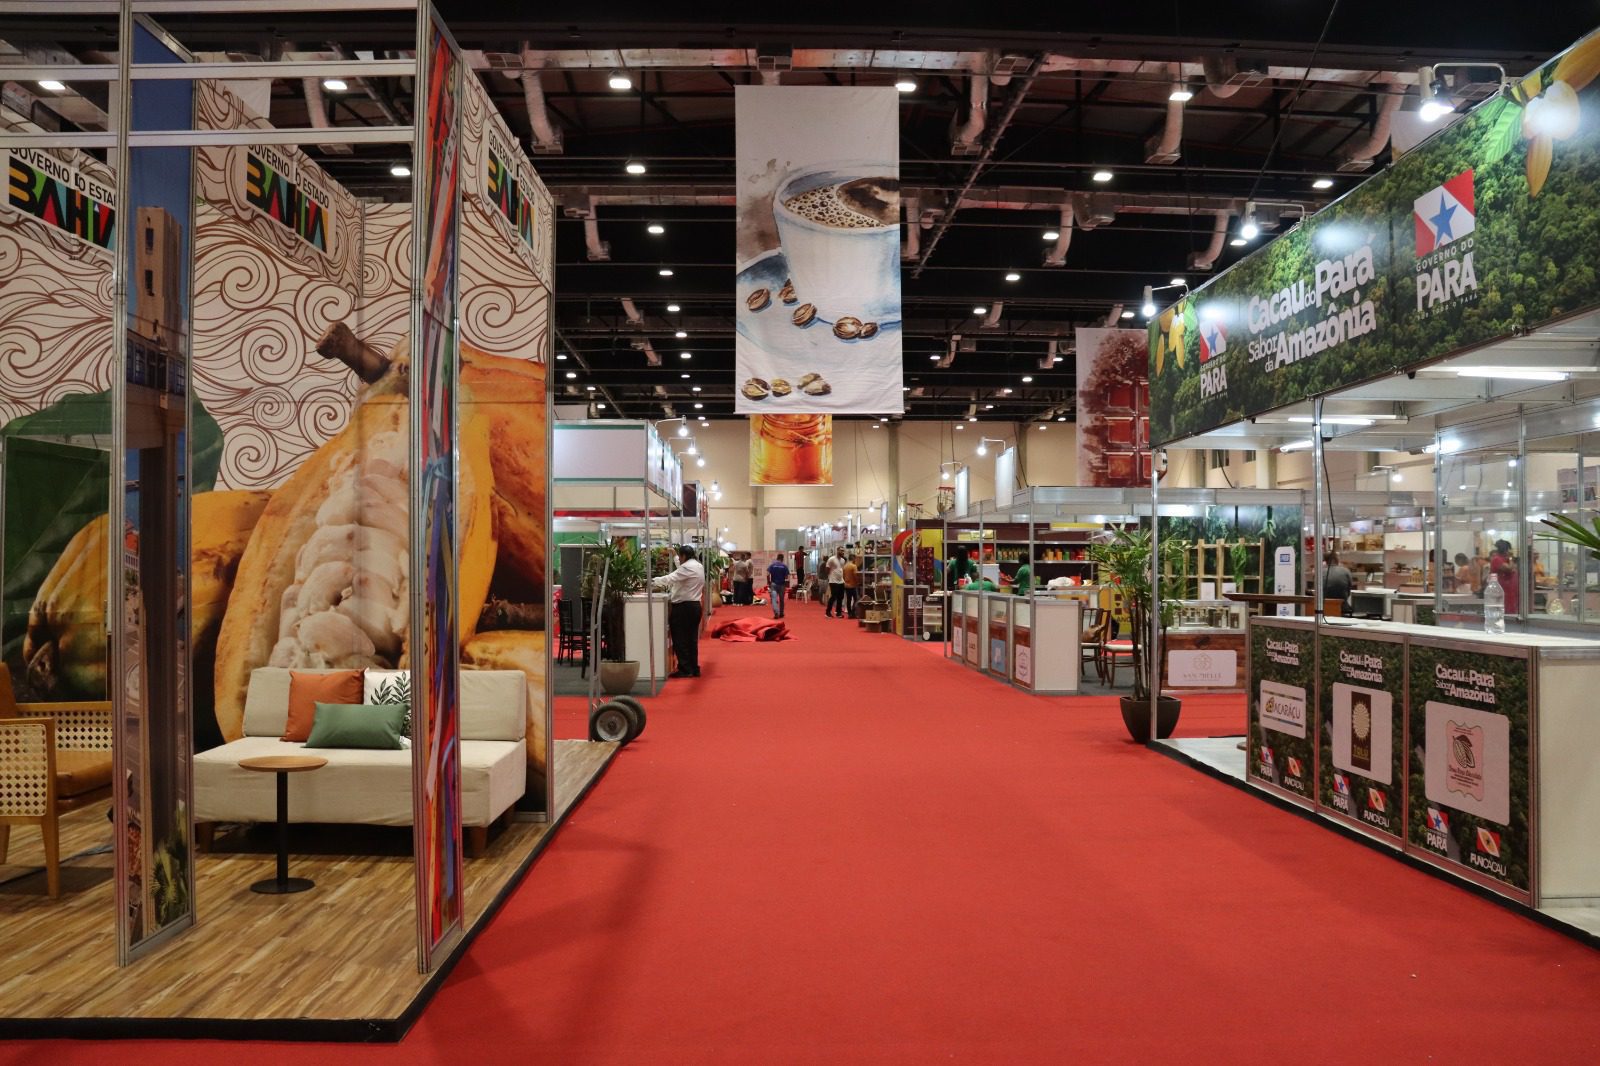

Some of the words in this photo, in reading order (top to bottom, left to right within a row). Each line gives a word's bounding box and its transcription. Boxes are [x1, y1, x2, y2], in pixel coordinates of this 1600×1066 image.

[302, 179, 329, 209] ESTADO
[1416, 246, 1457, 272] GOVERNO
[1461, 237, 1474, 252] DO
[1249, 279, 1305, 334] Cacau
[1304, 286, 1316, 308] do
[1315, 232, 1375, 308] Pará
[1248, 334, 1278, 363] Sabor
[1265, 357, 1274, 373] da
[1274, 290, 1377, 369] Amazônia
[1340, 650, 1361, 665] Cacau
[1364, 654, 1383, 670] Pará
[1350, 667, 1383, 683] Amazônia
[1436, 664, 1465, 682] Cacau
[1469, 670, 1495, 688] Pará
[1435, 680, 1451, 690] Sabor
[1450, 684, 1495, 704] Amazônia
[1470, 852, 1507, 876] FUNCACAU
